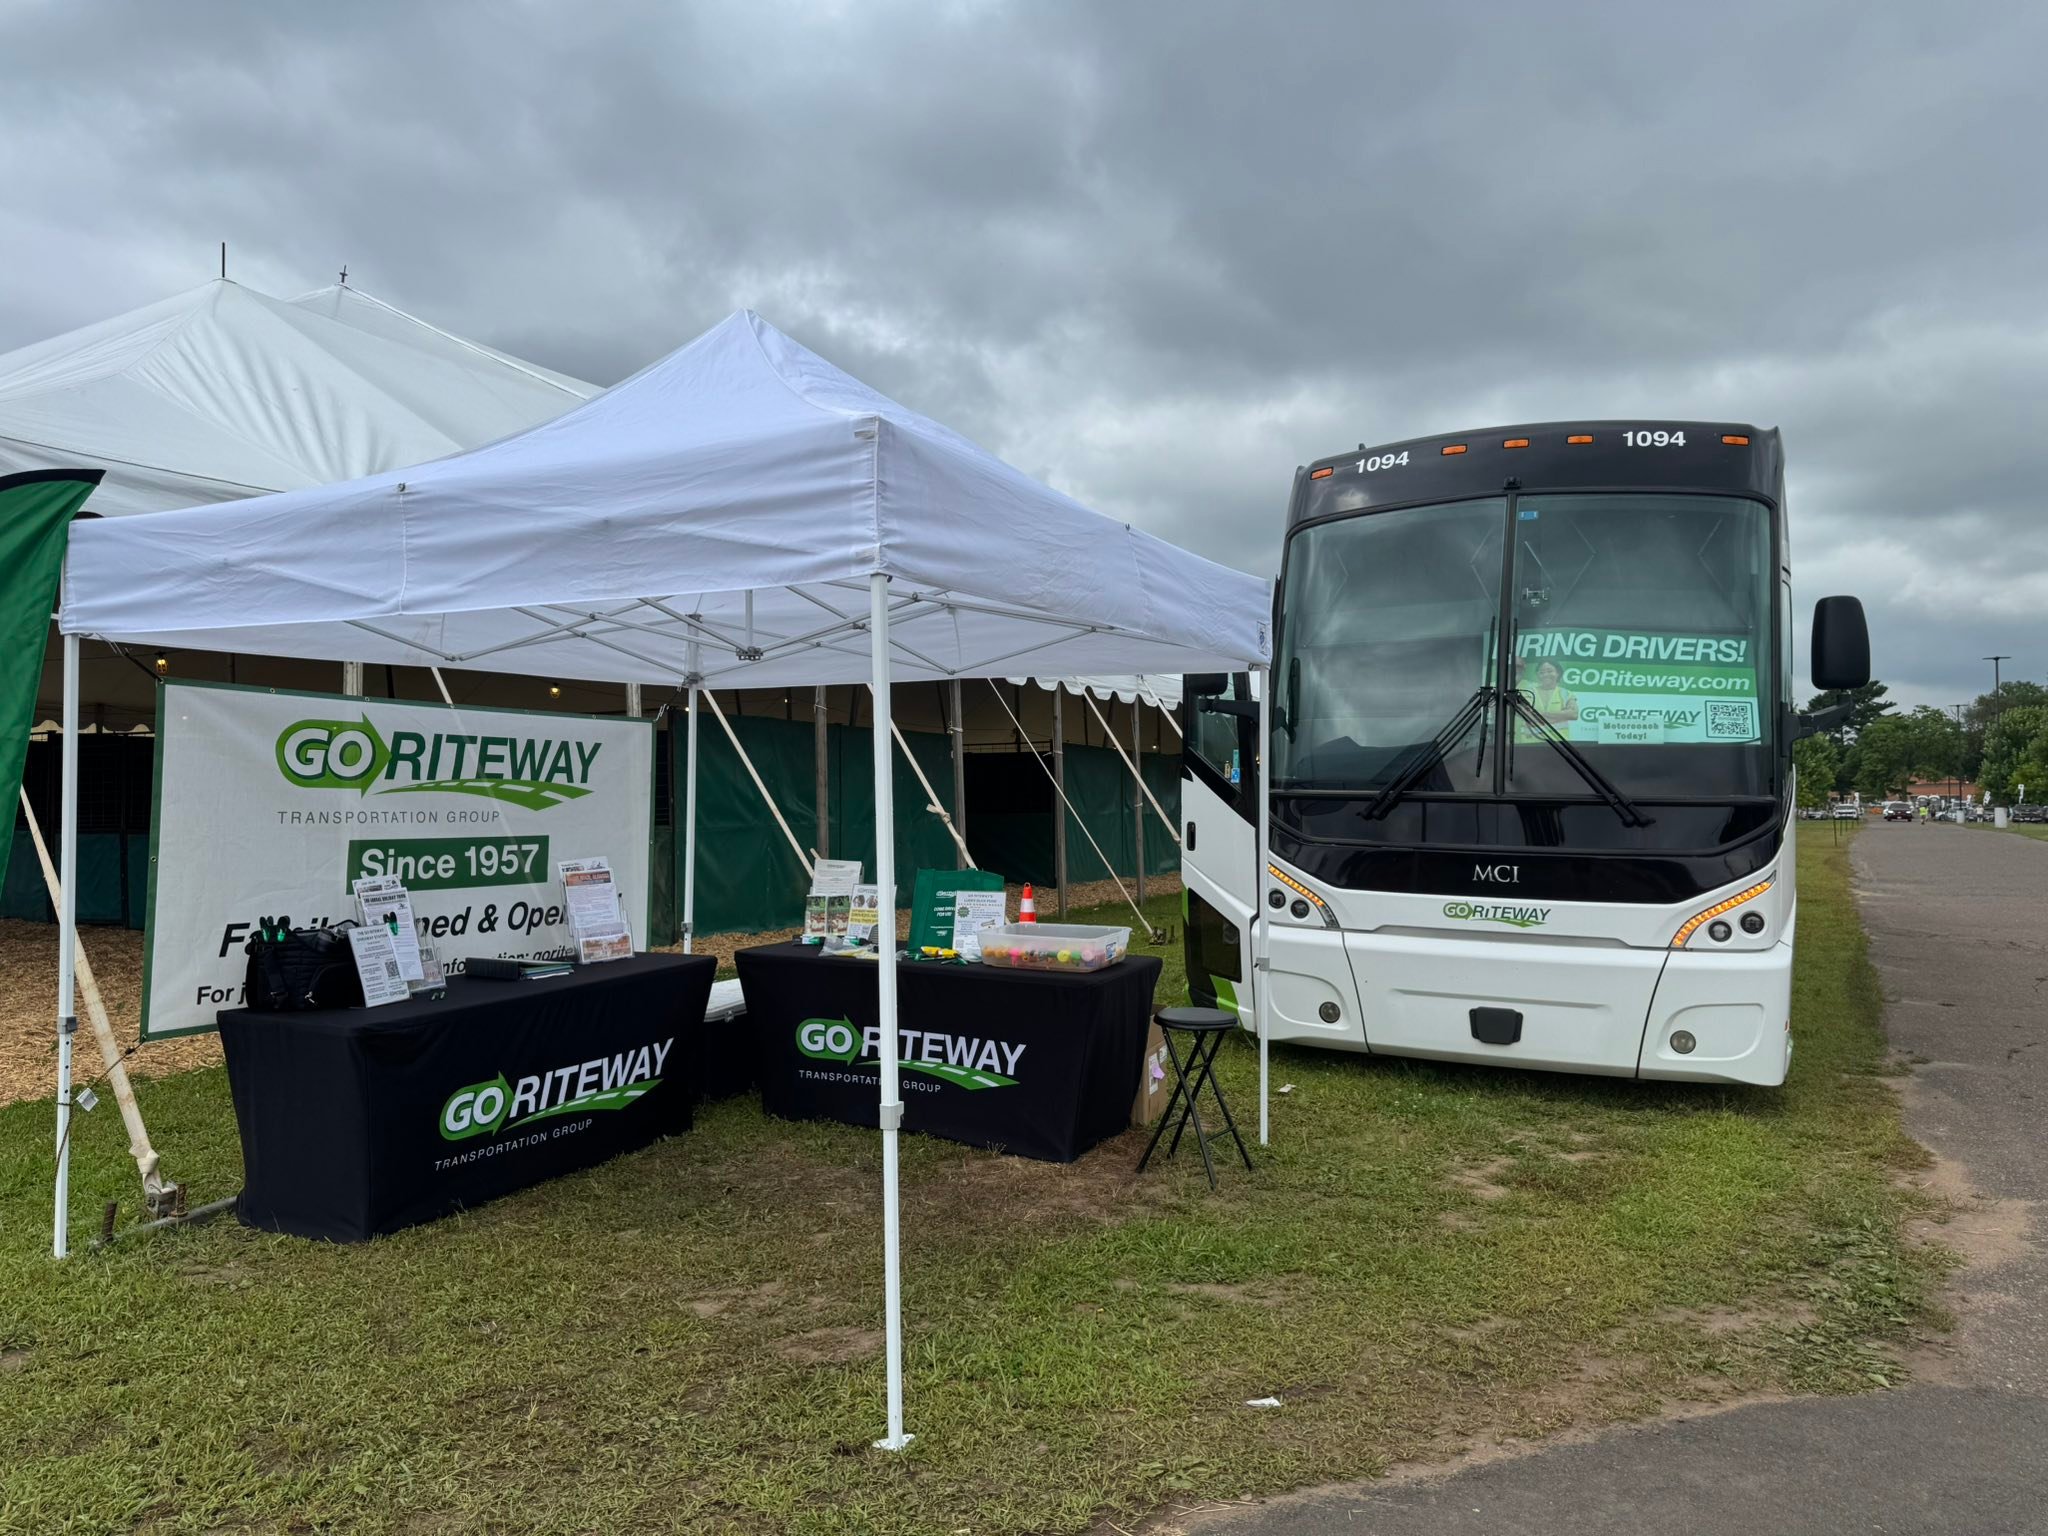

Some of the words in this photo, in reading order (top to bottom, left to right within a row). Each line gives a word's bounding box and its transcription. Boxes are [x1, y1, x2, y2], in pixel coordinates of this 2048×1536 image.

[1622, 431, 1686, 448] 1094
[1356, 451, 1410, 475] 1094
[1603, 634, 1747, 663] DRIVERS!
[1562, 667, 1750, 691] GORiteway.com
[1603, 722, 1659, 730] Motorcoach
[1615, 732, 1647, 741] Today!
[277, 810, 438, 825] TRANSPORTATION
[446, 810, 501, 824] GROUP
[360, 848, 455, 880] Since
[464, 843, 540, 877] 1957
[1472, 864, 1520, 884] MCI
[477, 903, 499, 934] &
[196, 985, 235, 1005] For
[860, 1026, 1027, 1076] RTEWAY
[902, 1080, 942, 1093] GROUP
[434, 1131, 548, 1172] TRANSPORTATION
[552, 1118, 594, 1139] GROUP
